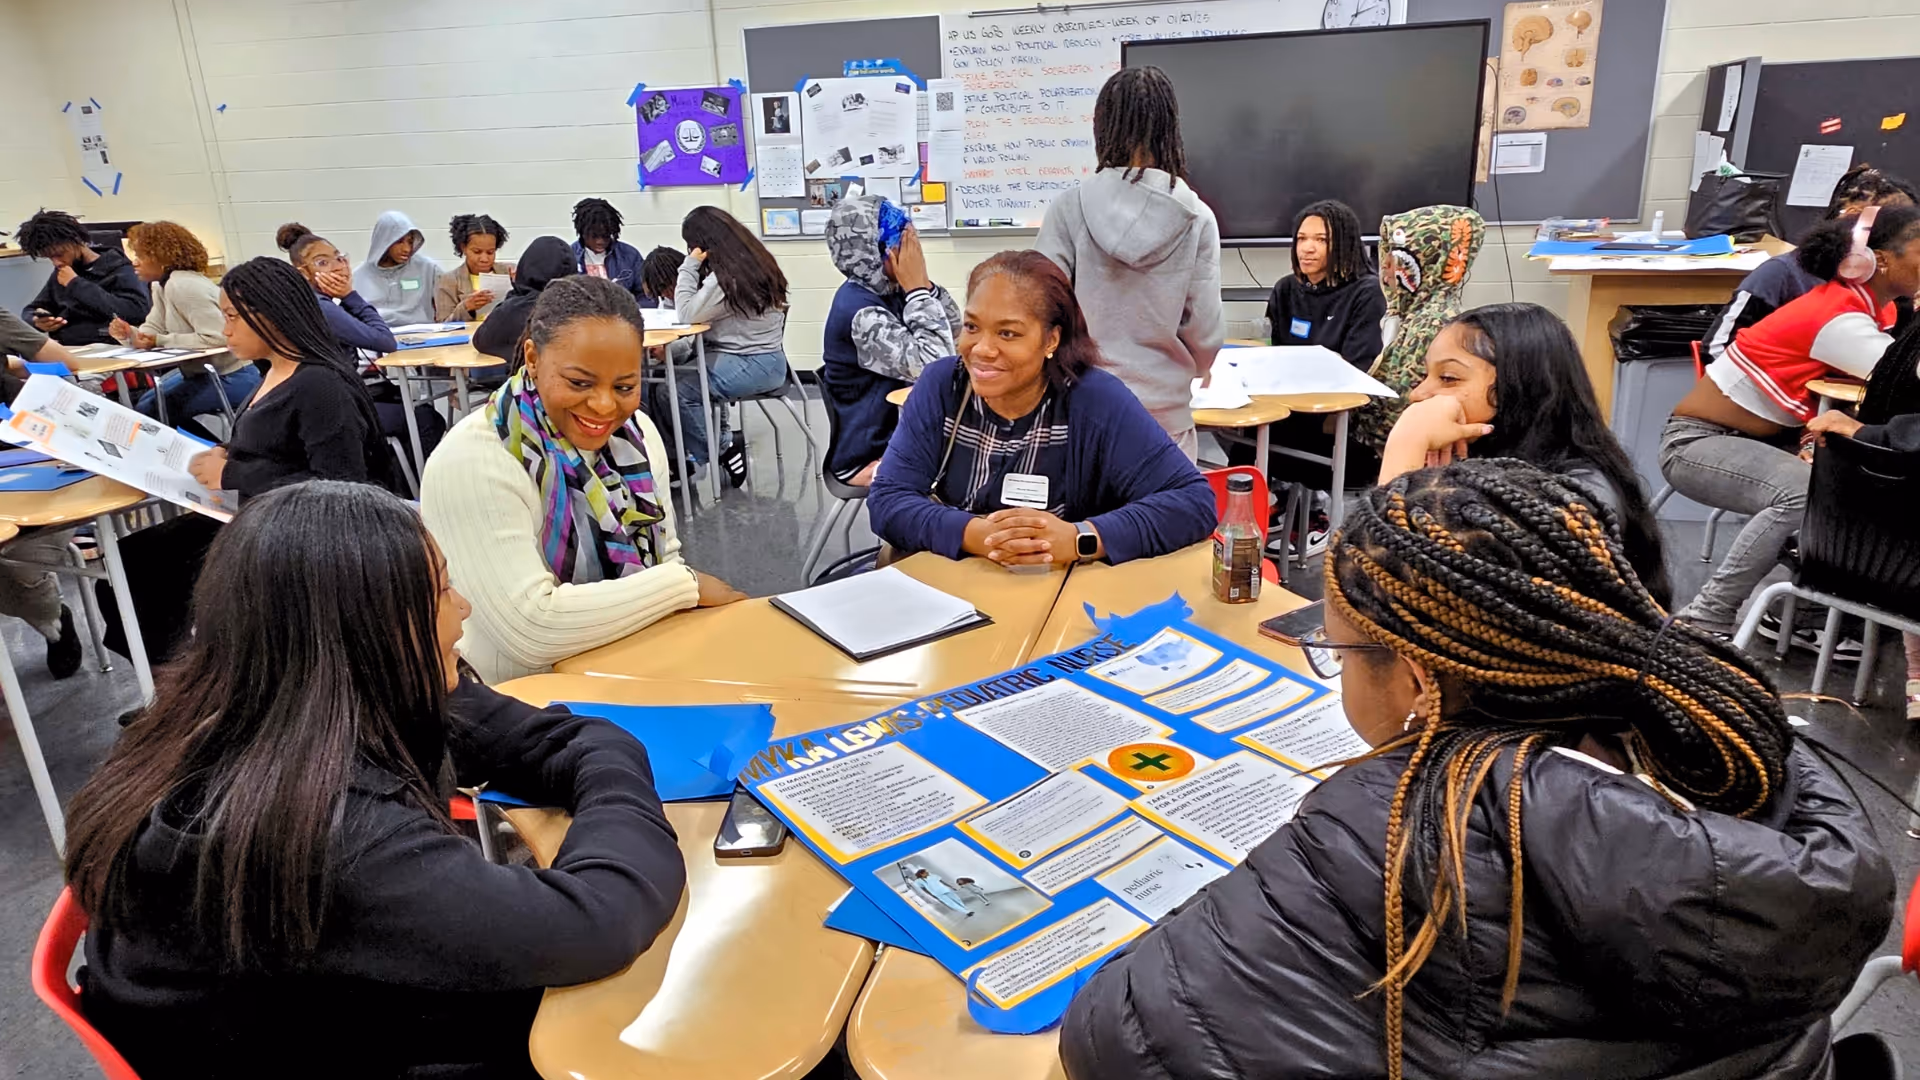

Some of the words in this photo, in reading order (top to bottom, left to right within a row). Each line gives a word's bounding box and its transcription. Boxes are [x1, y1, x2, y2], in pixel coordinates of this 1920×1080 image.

[963, 30, 976, 40] US
[1012, 24, 1046, 36] WEEKLY
[1145, 16, 1159, 26] OF
[991, 44, 1010, 52] HOW
[1016, 40, 1058, 50] POLITICAL
[976, 58, 1003, 66] POLICY
[994, 92, 1034, 101] POLITICAL
[980, 104, 1032, 114] CONTRIBUTE
[1038, 102, 1050, 110] TO
[1026, 138, 1056, 148] PUBLIC
[972, 156, 996, 164] VALID
[960, 184, 1001, 194] DESCRIBE
[1007, 182, 1022, 191] THE
[962, 198, 992, 209] VOTER
[917, 668, 1056, 718] PEDIATRIC
[1047, 632, 1137, 674] NURSE
[777, 780, 811, 793] HIGHER
[818, 770, 841, 779] HIGH
[785, 768, 825, 784] MAINTAIN
[816, 778, 841, 788] TERM
[1146, 795, 1168, 806] TAKE
[1167, 779, 1202, 797] COURSES
[1154, 800, 1173, 811] FOR
[1178, 784, 1208, 800] CAREER
[1192, 791, 1215, 804] TERM
[1123, 868, 1164, 895] pediatric
[1134, 882, 1162, 900] nurse
